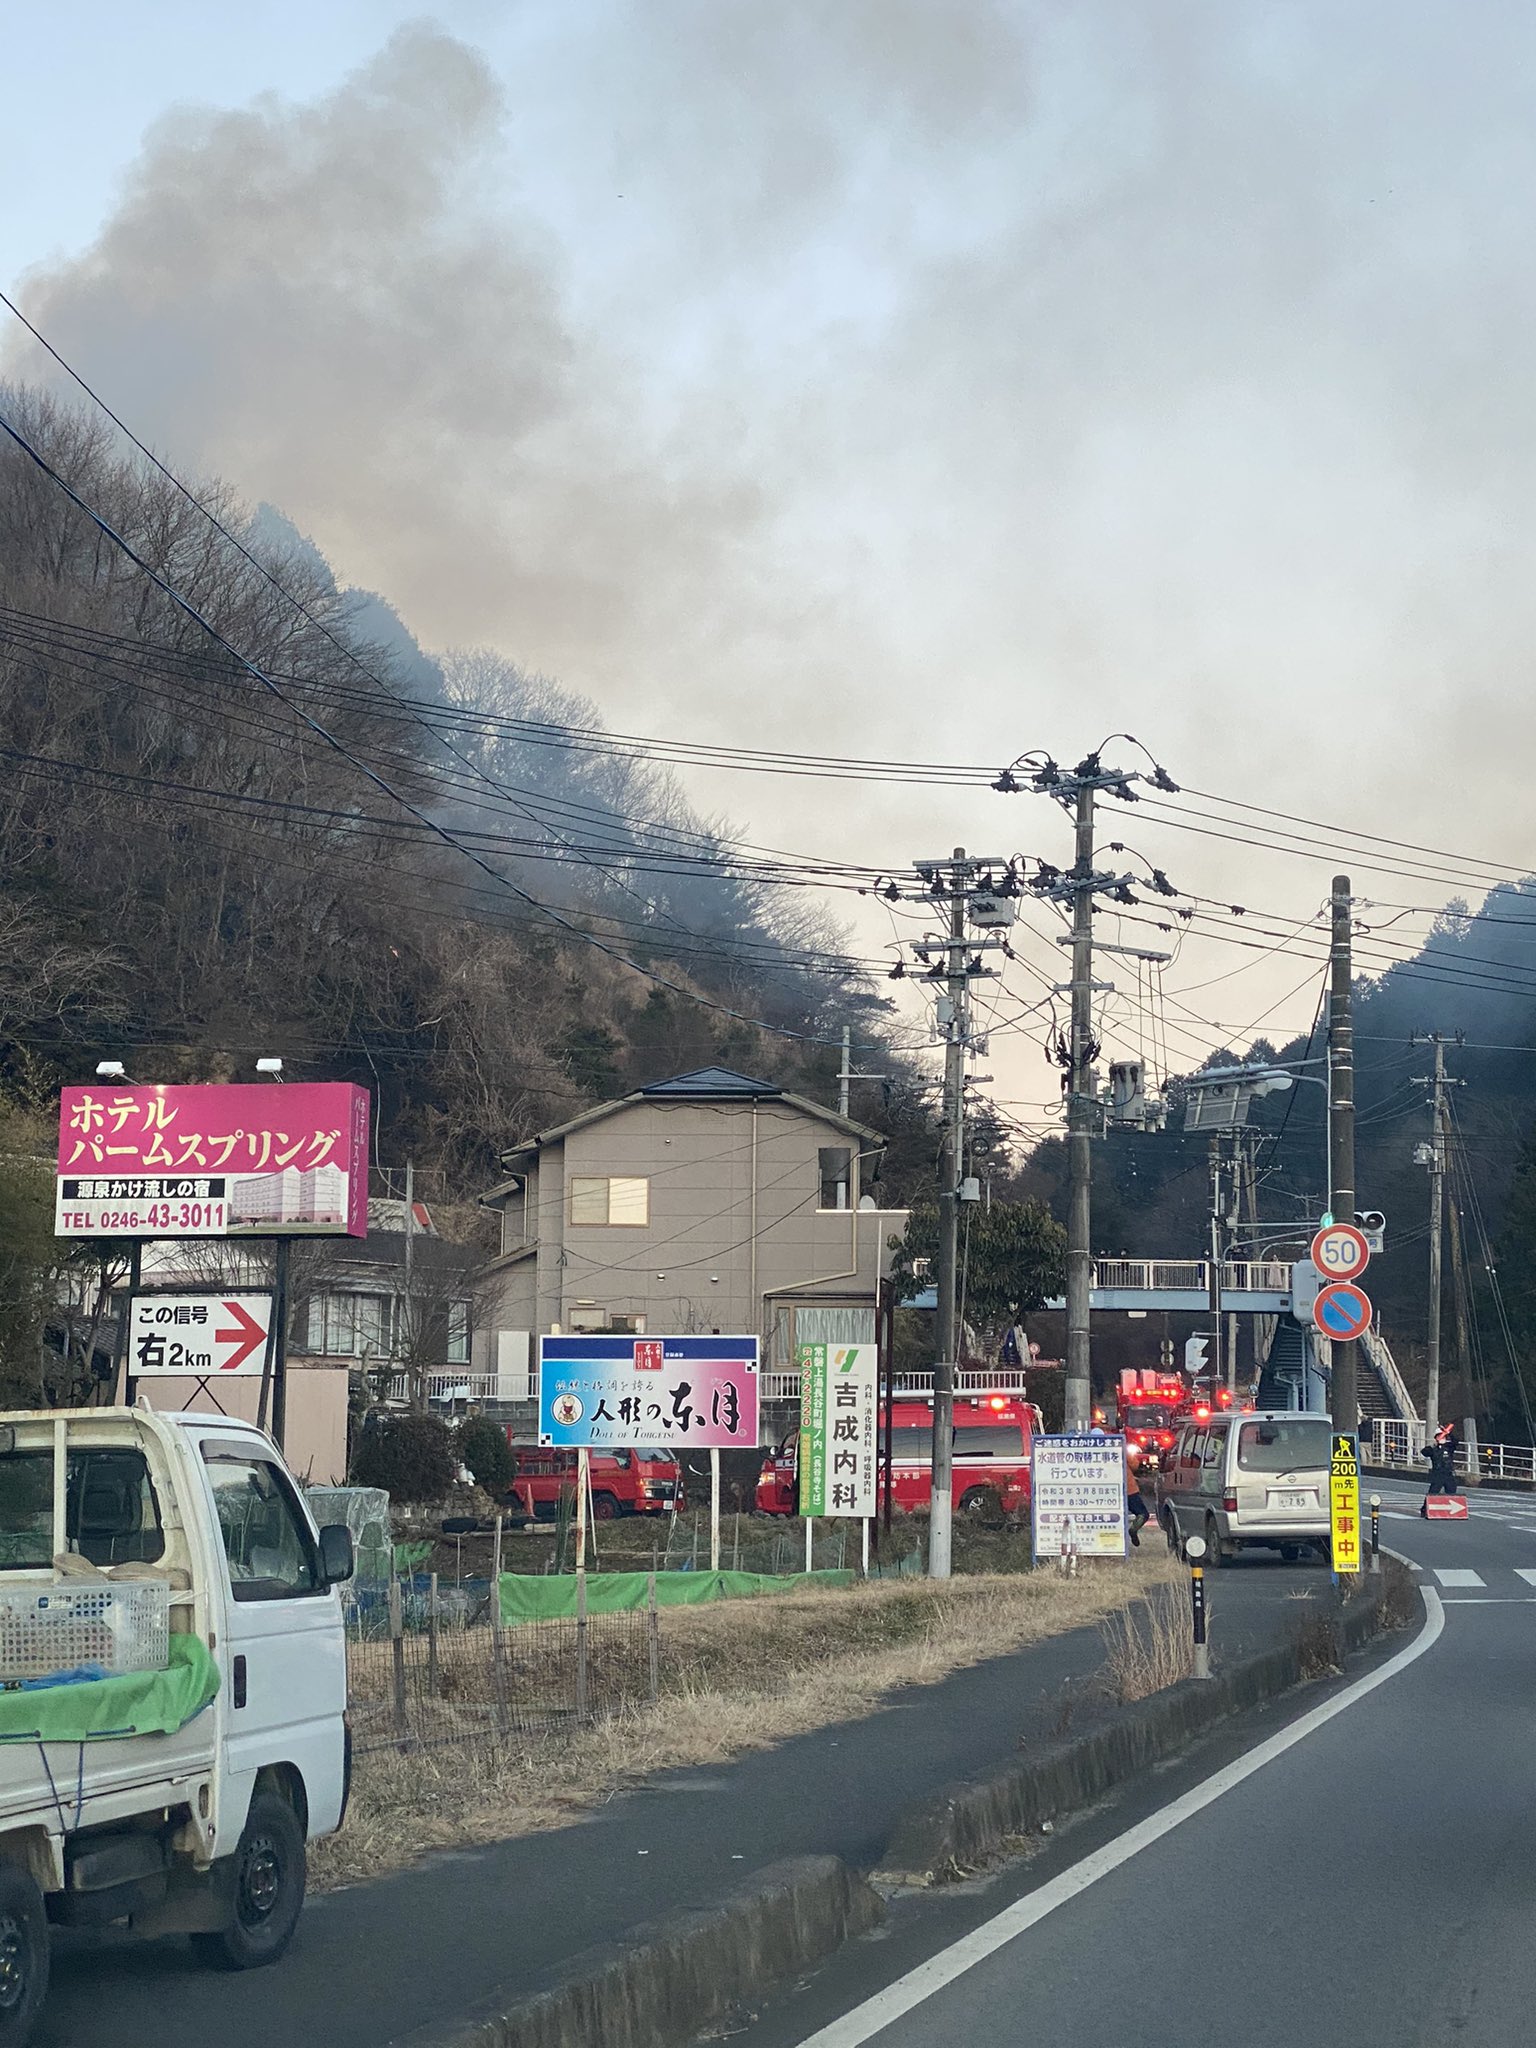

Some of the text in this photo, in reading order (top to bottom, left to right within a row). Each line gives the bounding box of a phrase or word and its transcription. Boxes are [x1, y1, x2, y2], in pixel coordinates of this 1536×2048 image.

[70, 1095, 180, 1131] ホテル
[66, 1129, 341, 1169] パームスプリング
[77, 1180, 211, 1199] 源泉かけ流しの宿
[62, 1203, 224, 1228] TEL 0246-43-3011
[1325, 1240, 1356, 1264] 50
[137, 1305, 209, 1325] この信号
[136, 1333, 212, 1368] 右2km
[833, 1382, 859, 1509] 吉成内科
[1035, 1439, 1121, 1447] ご迷惑をおかけします
[1038, 1452, 1119, 1464] 水道管の取替工事を
[1332, 1463, 1357, 1475] 200
[1051, 1467, 1108, 1479] 行っています。
[1334, 1479, 1354, 1489] m先
[1336, 1494, 1355, 1557] 工事中
